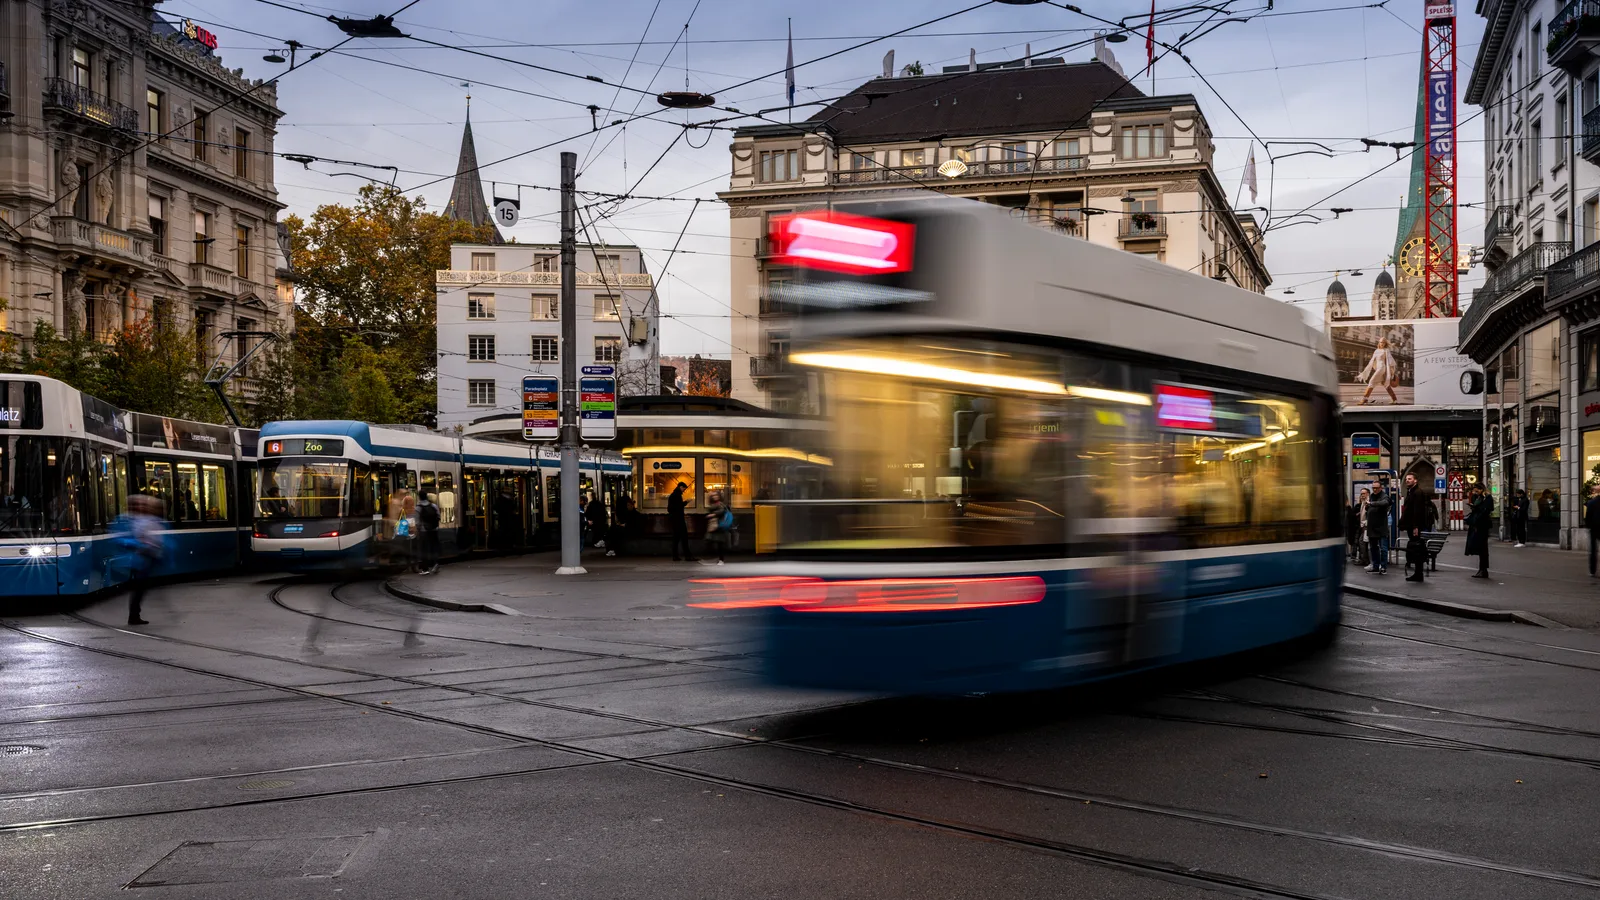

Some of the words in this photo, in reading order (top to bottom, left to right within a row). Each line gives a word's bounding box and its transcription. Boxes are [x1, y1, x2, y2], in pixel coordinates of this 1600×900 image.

[1429, 6, 1453, 15] SPLEISS
[197, 26, 218, 50] UBS
[1431, 73, 1452, 153] allreal
[500, 208, 514, 221] 15
[272, 442, 279, 452] 6
[305, 441, 323, 452] Zoo
